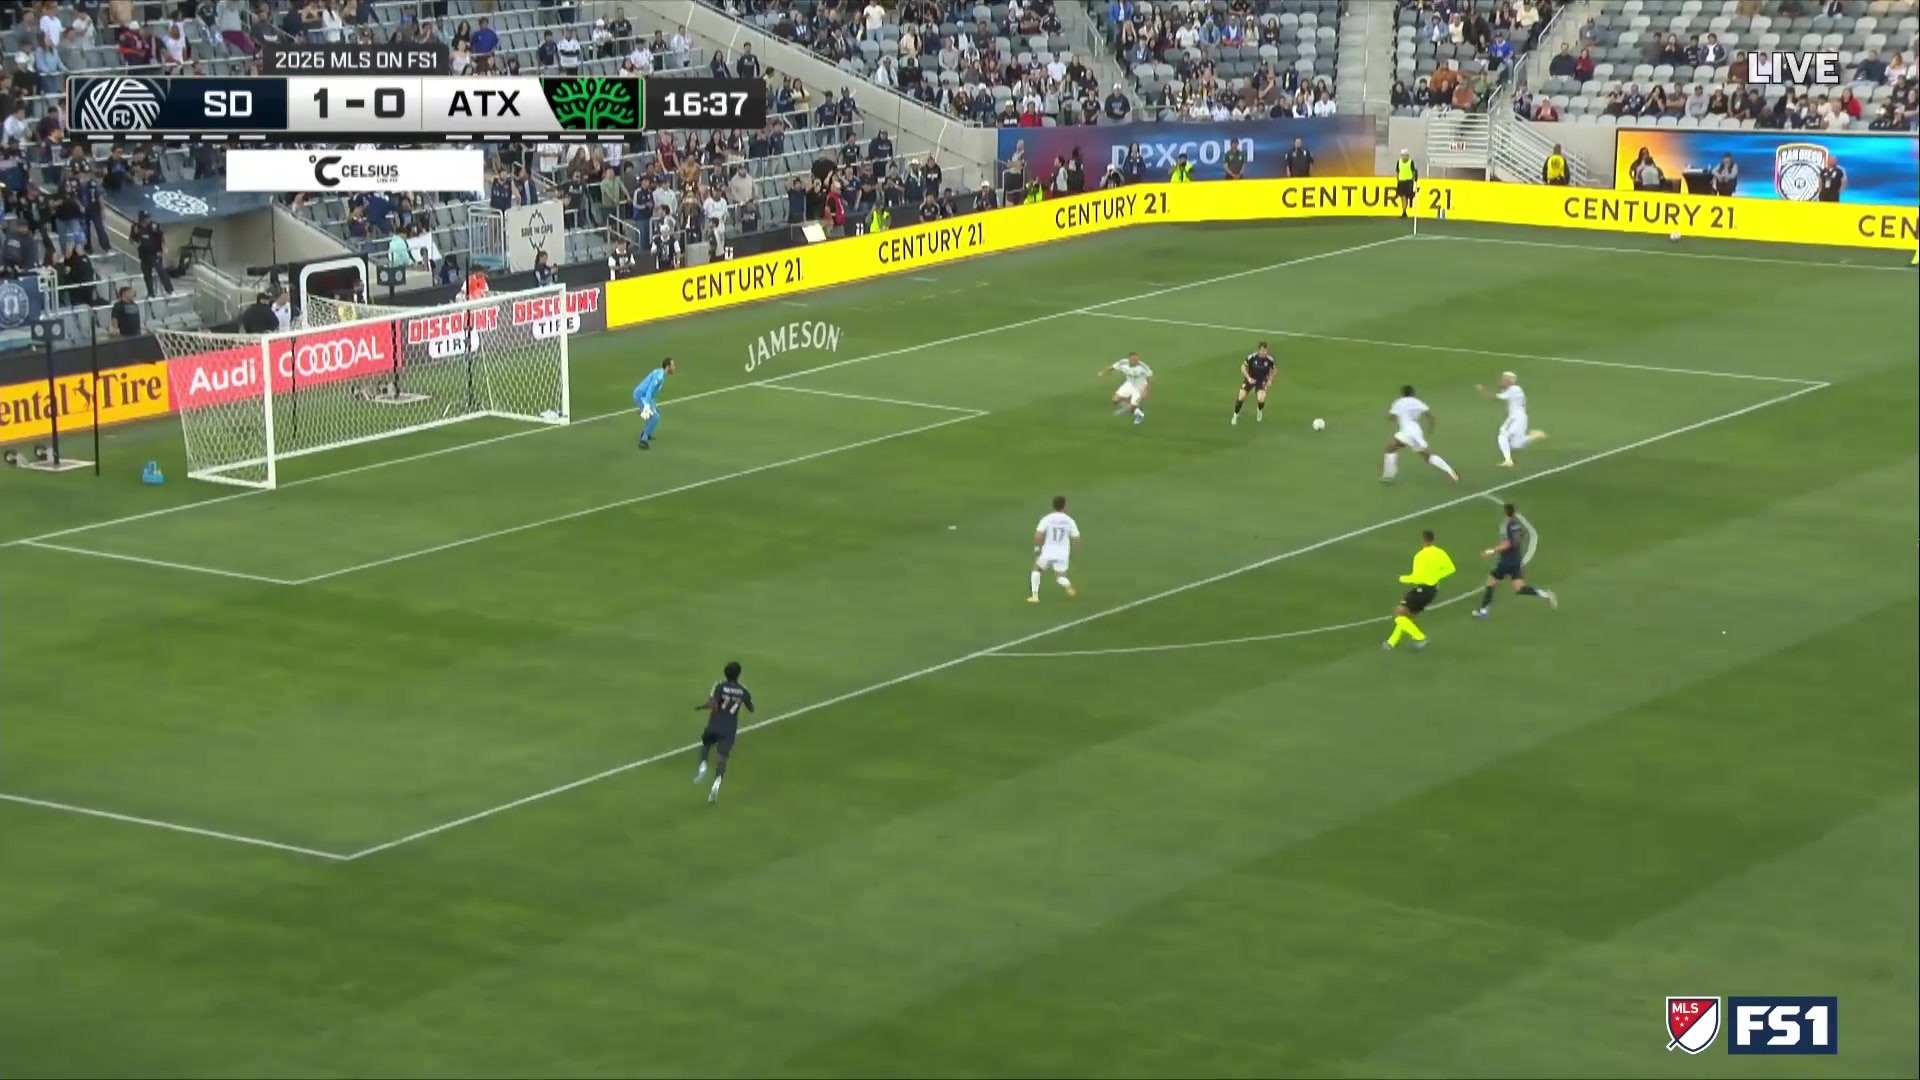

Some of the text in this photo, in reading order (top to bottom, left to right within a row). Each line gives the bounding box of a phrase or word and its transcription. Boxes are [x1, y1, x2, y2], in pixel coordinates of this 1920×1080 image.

[1055, 192, 1167, 229] CENTURY 21
[1429, 188, 1452, 210] 21
[1564, 197, 1735, 229] CENTURY 21
[878, 222, 983, 264] CENTURY 21
[682, 257, 801, 302] CENTURY 21
[435, 337, 471, 353] TIR
[745, 321, 841, 372] JAMESON
[98, 372, 162, 409] Tire
[189, 358, 256, 395] Audi
[1052, 527, 1065, 543] 17
[721, 694, 741, 714] 77
